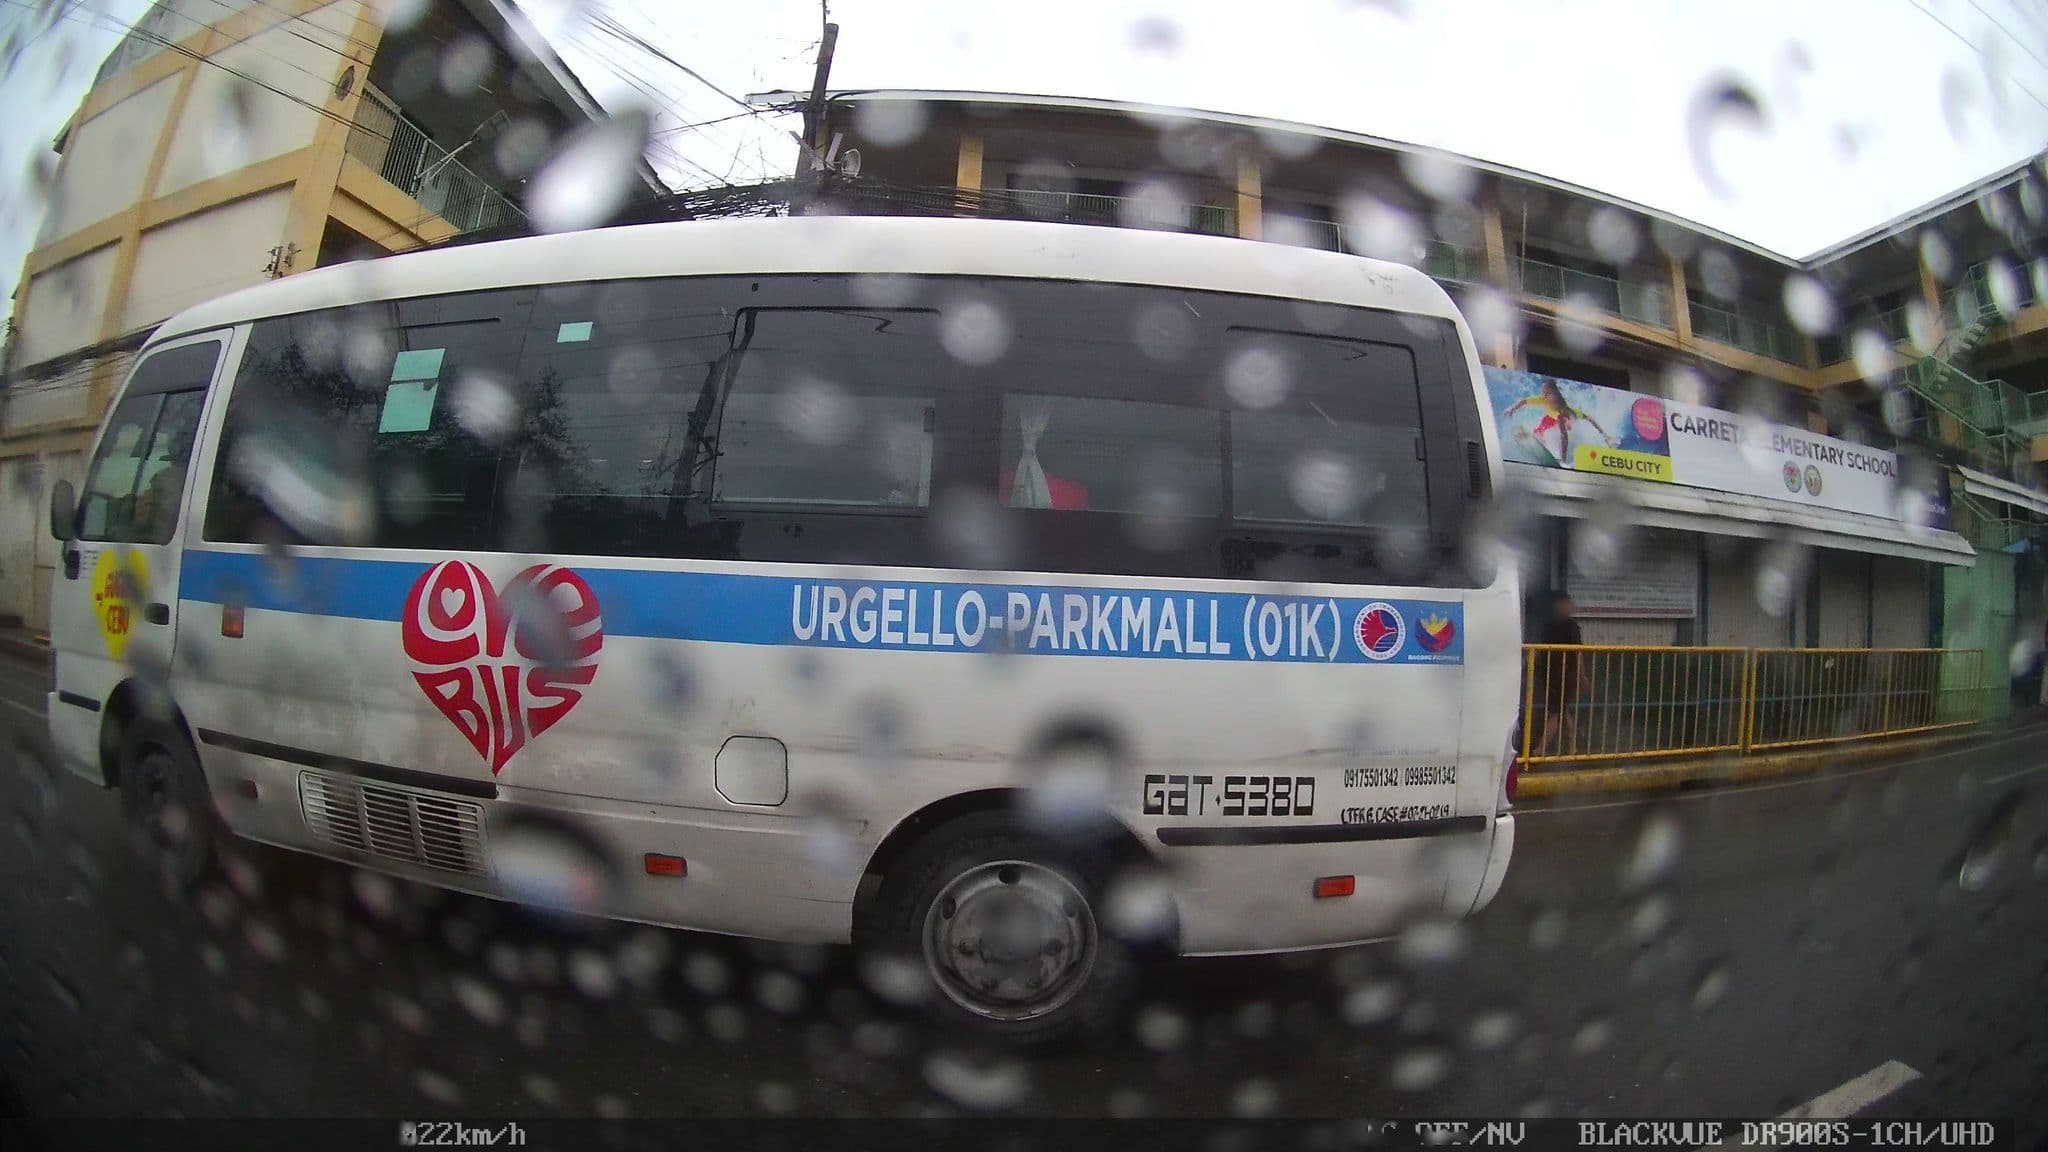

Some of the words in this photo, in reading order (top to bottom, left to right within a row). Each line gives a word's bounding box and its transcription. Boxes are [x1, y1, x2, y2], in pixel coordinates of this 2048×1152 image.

[1601, 455, 1633, 470] CEBU
[1636, 460, 1661, 474] CITY
[1670, 412, 1744, 446] CARRET
[1757, 432, 1845, 467] EMENTARY
[1847, 451, 1896, 478] SCHOOL
[792, 584, 1231, 655] URGELLO-PARKMALL
[1243, 595, 1341, 662] (01K)
[411, 663, 598, 778] BUS
[1344, 768, 1398, 788] 09175501342
[1405, 766, 1456, 786] 09985501342
